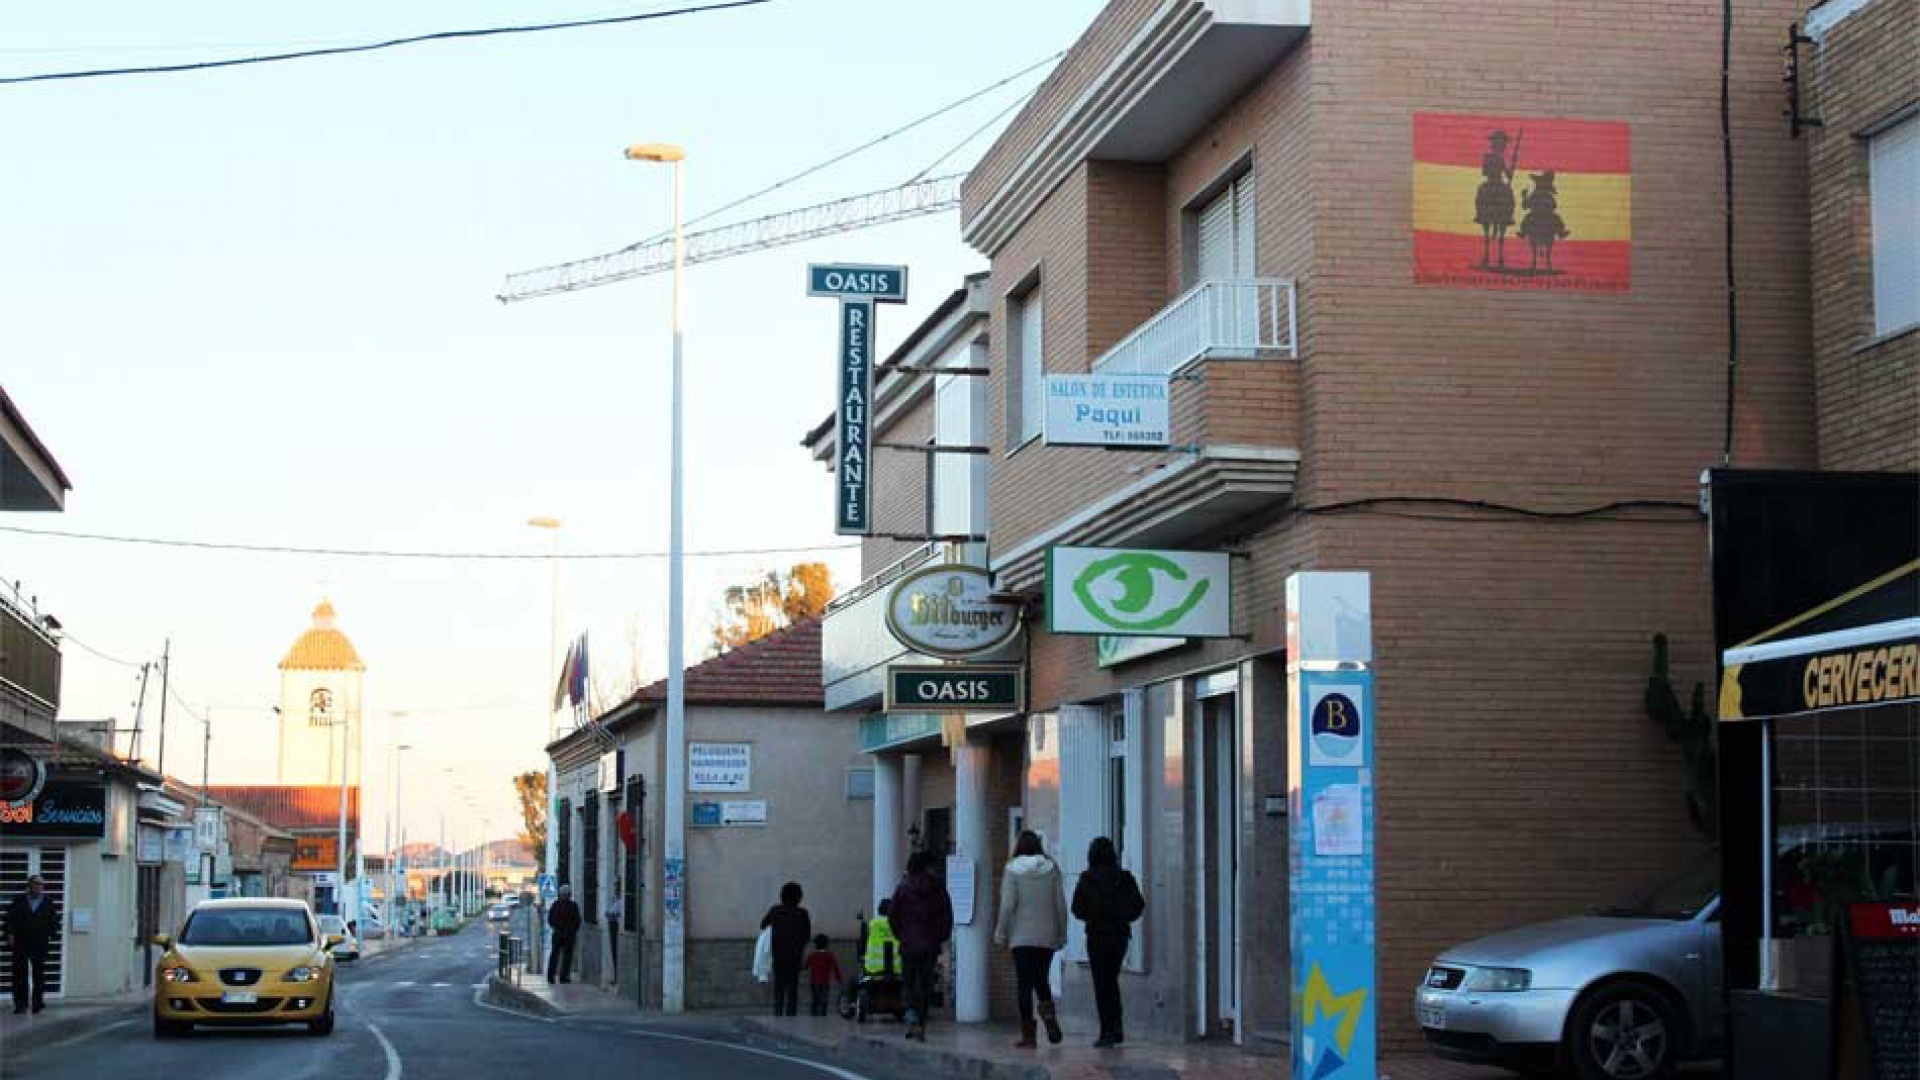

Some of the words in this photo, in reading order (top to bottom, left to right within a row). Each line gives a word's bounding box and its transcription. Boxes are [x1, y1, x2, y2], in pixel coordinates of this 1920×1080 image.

[825, 272, 888, 293] OASIS
[1092, 383, 1107, 399] DE
[844, 308, 866, 522] RESTAURANTE
[1076, 403, 1141, 427] Paqui
[910, 593, 1004, 631] Bitburger
[917, 680, 989, 700] OASIS
[1326, 700, 1348, 730] B
[38, 798, 102, 823] Servicios
